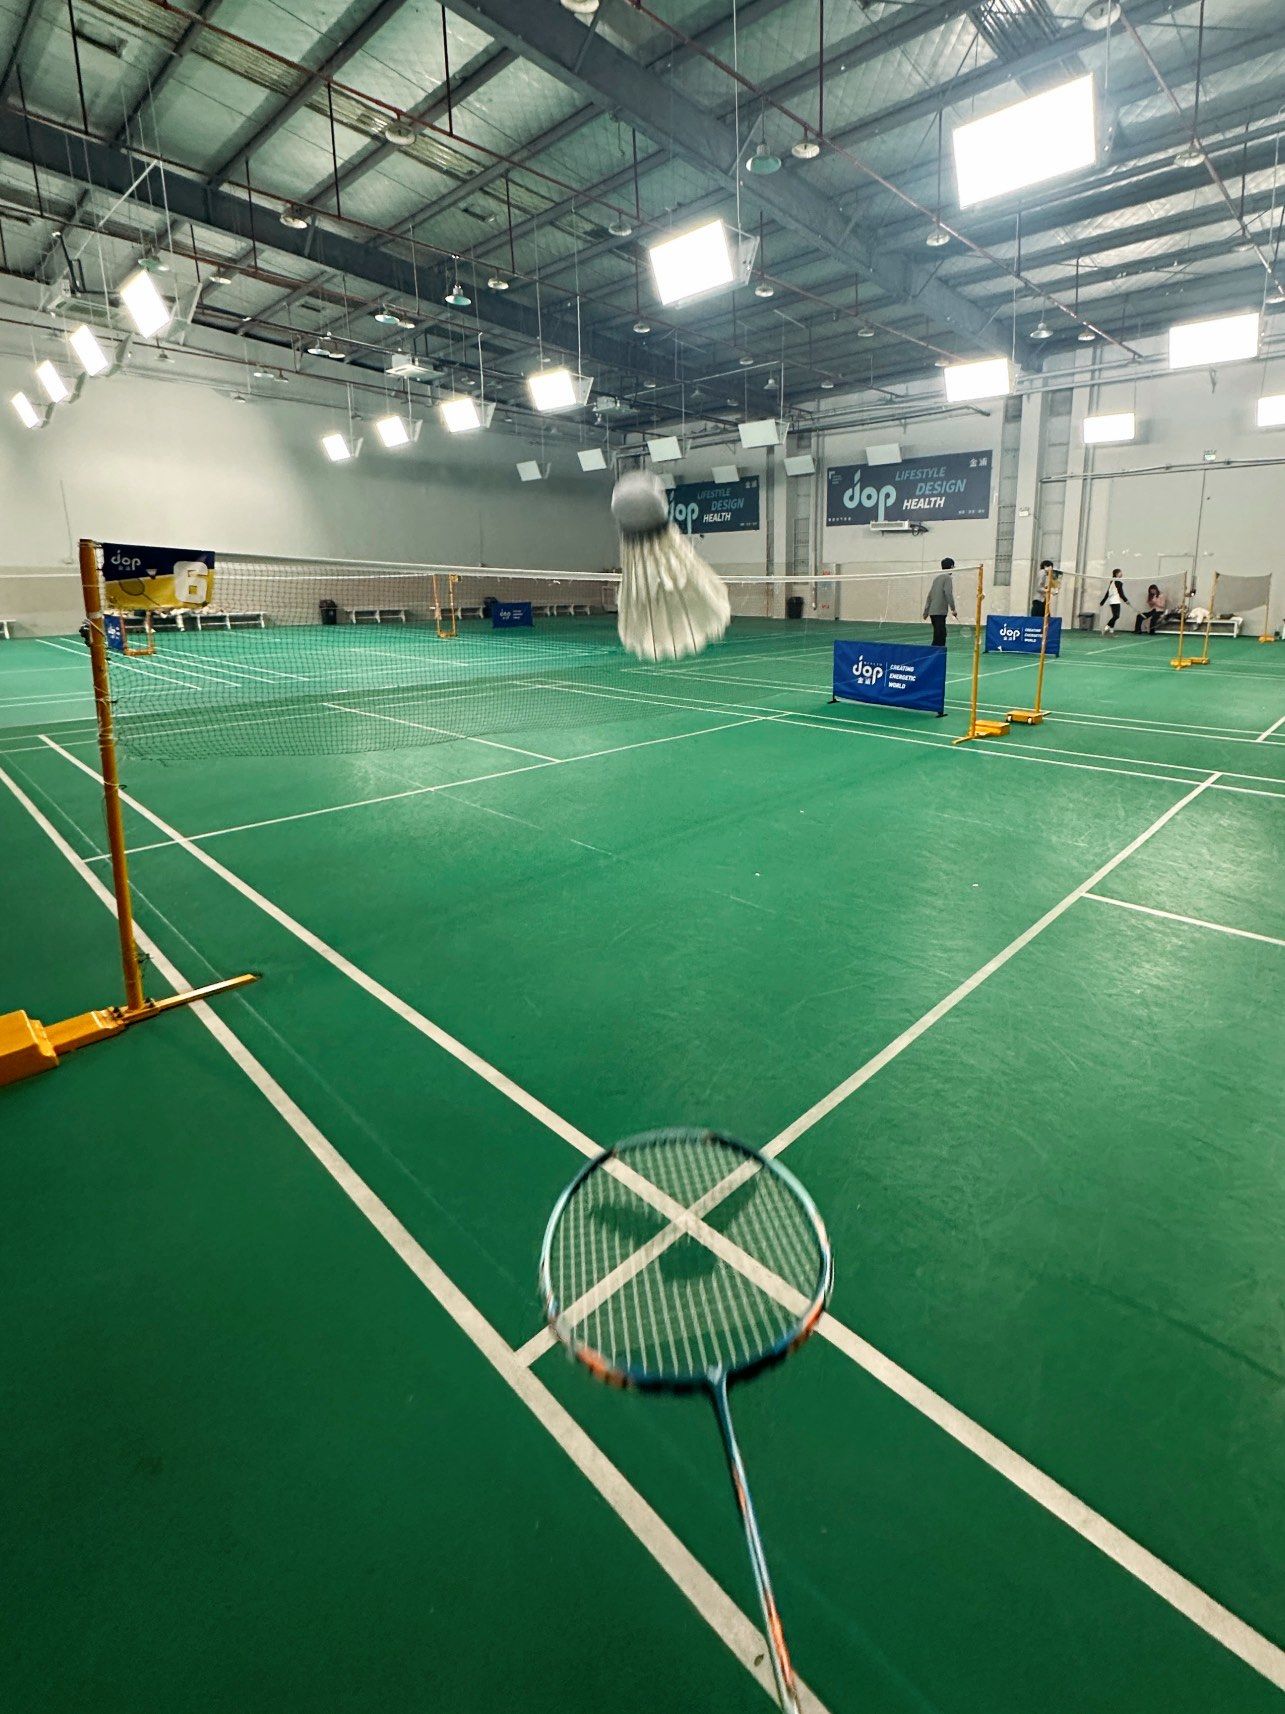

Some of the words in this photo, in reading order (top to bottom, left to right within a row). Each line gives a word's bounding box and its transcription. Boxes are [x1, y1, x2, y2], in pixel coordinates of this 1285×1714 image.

[895, 467, 946, 481] LIFESTYLE
[698, 488, 731, 500] LIFESTYLE
[916, 479, 967, 496] DESIGN
[843, 469, 896, 522] dop
[711, 498, 744, 511] DESIGN
[903, 497, 945, 510] HEALTH
[703, 512, 731, 523] HEALTH
[111, 549, 141, 570] dop
[173, 561, 208, 605] 6
[1000, 623, 1020, 640] dop
[852, 655, 883, 685] dop
[890, 664, 914, 672] CREATING
[889, 673, 916, 682] ENERGETIC
